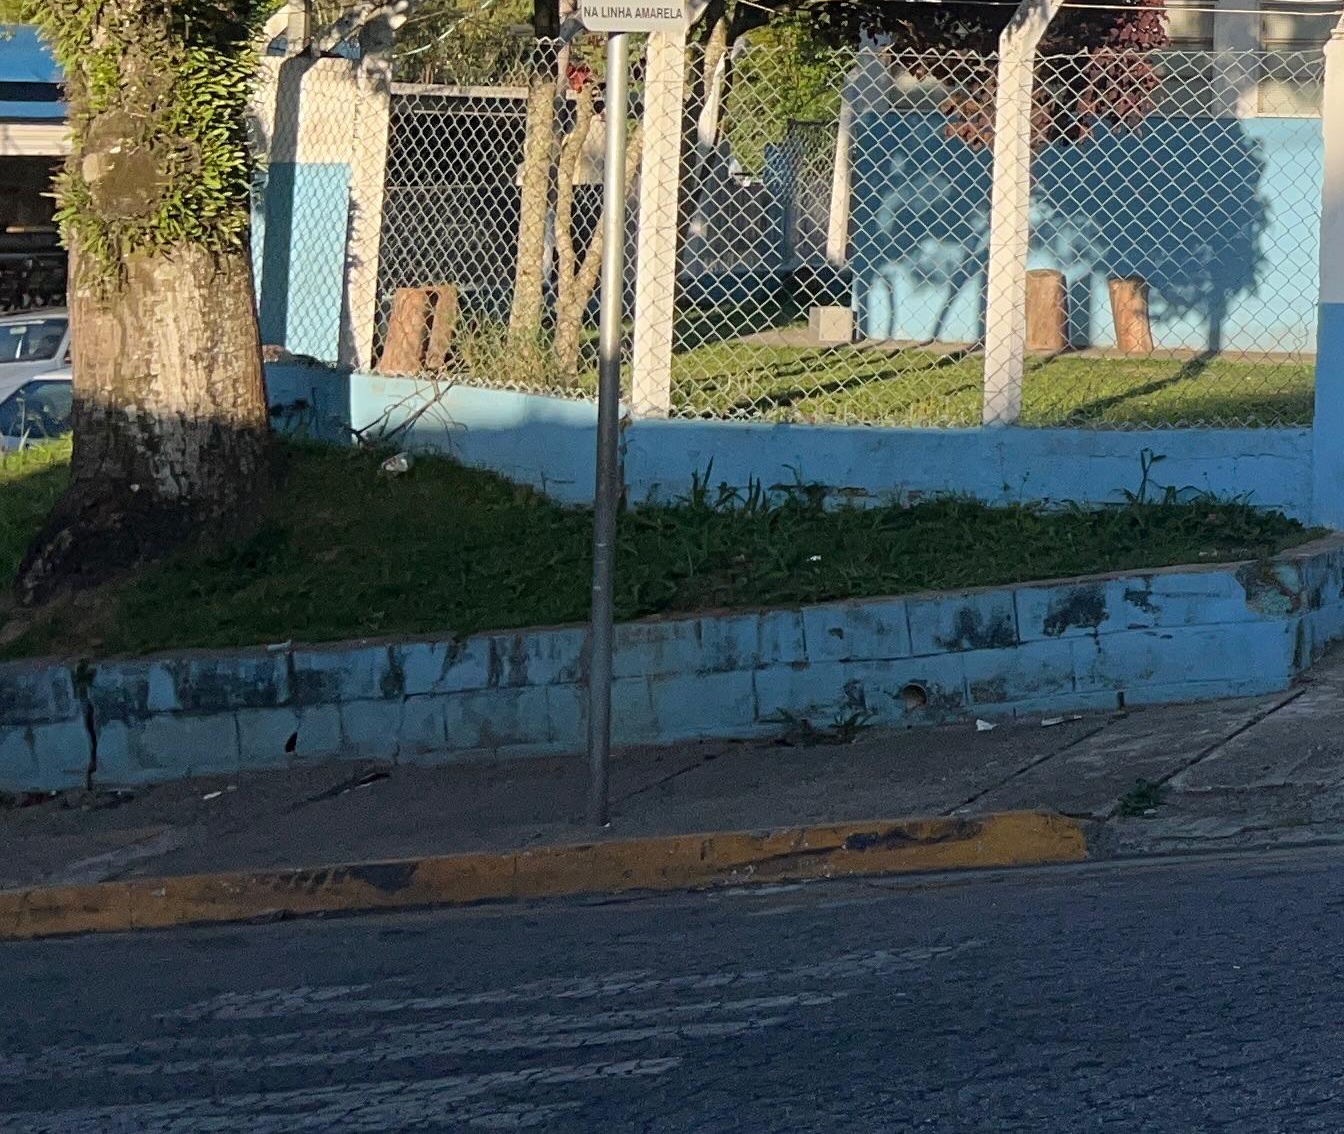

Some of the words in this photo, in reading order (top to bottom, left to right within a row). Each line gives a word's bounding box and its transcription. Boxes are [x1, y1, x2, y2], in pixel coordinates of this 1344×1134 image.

[583, 6, 599, 17] NA
[601, 6, 633, 18] LINHA
[634, 7, 683, 19] AMARELA
